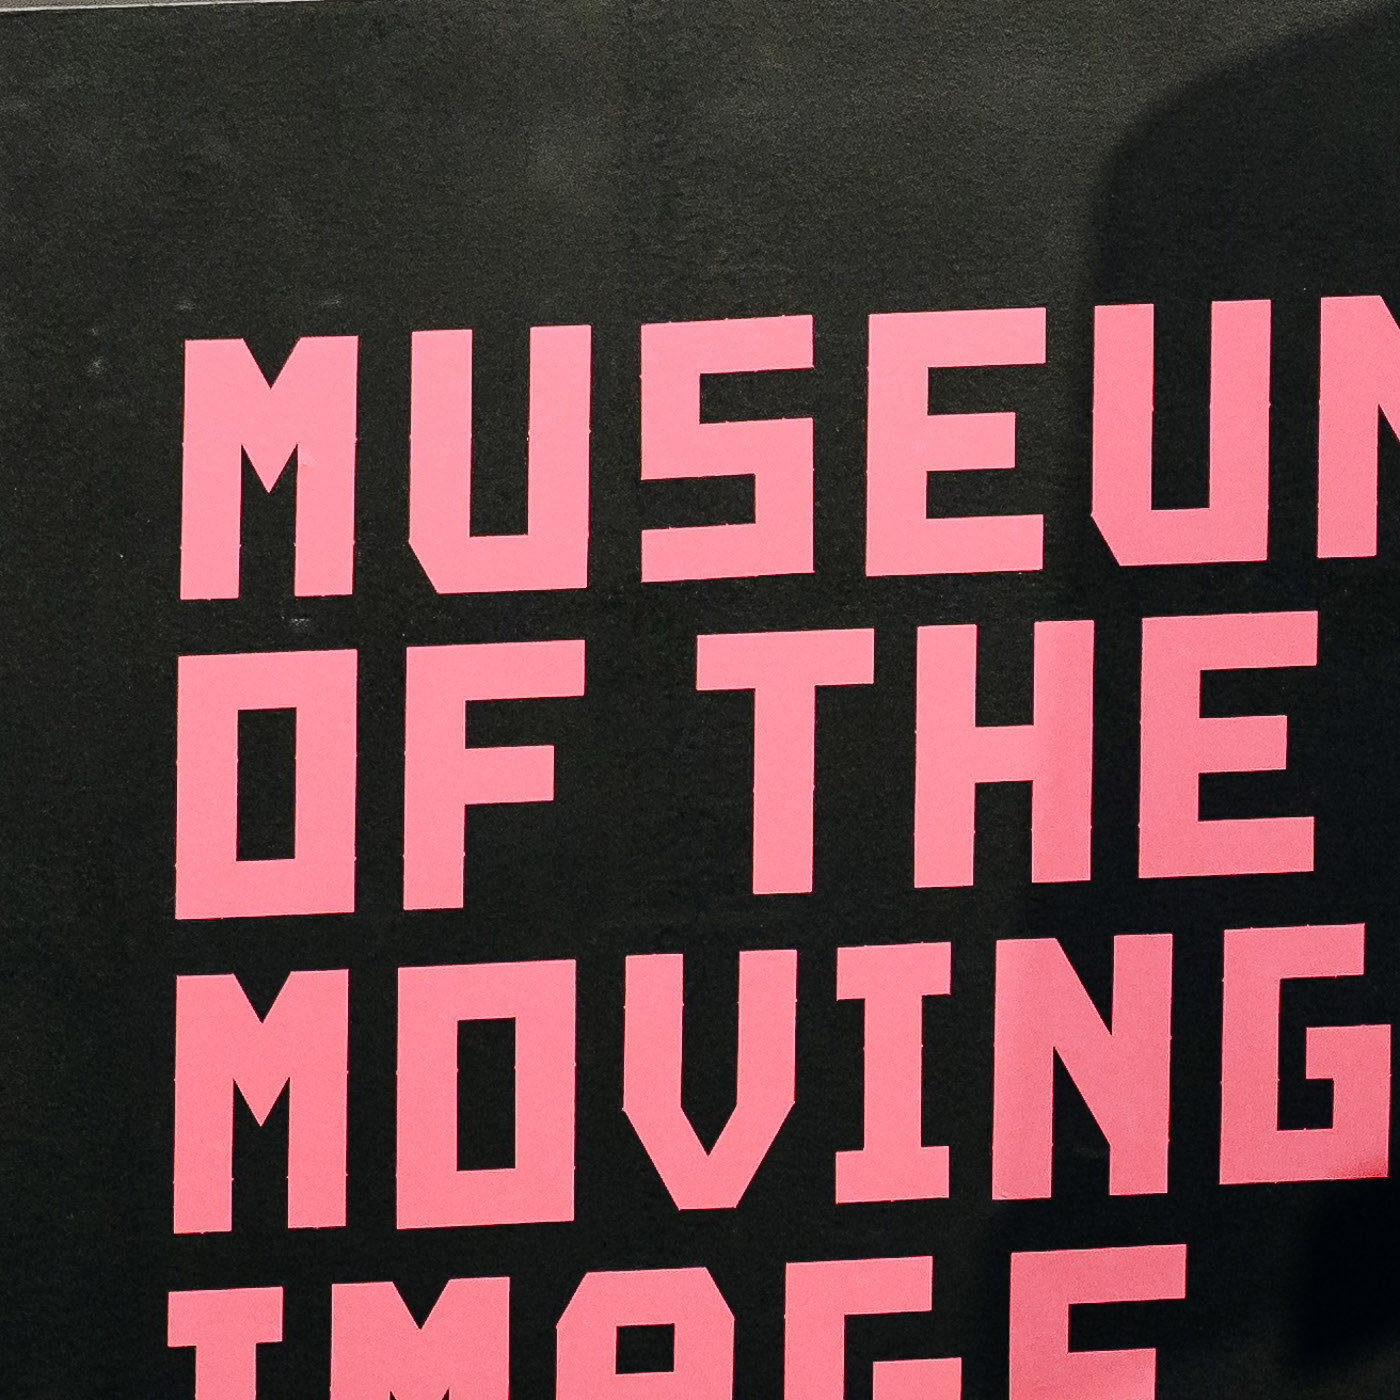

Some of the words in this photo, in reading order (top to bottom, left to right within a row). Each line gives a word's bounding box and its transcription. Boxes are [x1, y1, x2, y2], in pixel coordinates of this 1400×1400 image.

[175, 640, 585, 920] OF
[696, 611, 1318, 895] THE
[173, 923, 1391, 1234] MOVING
